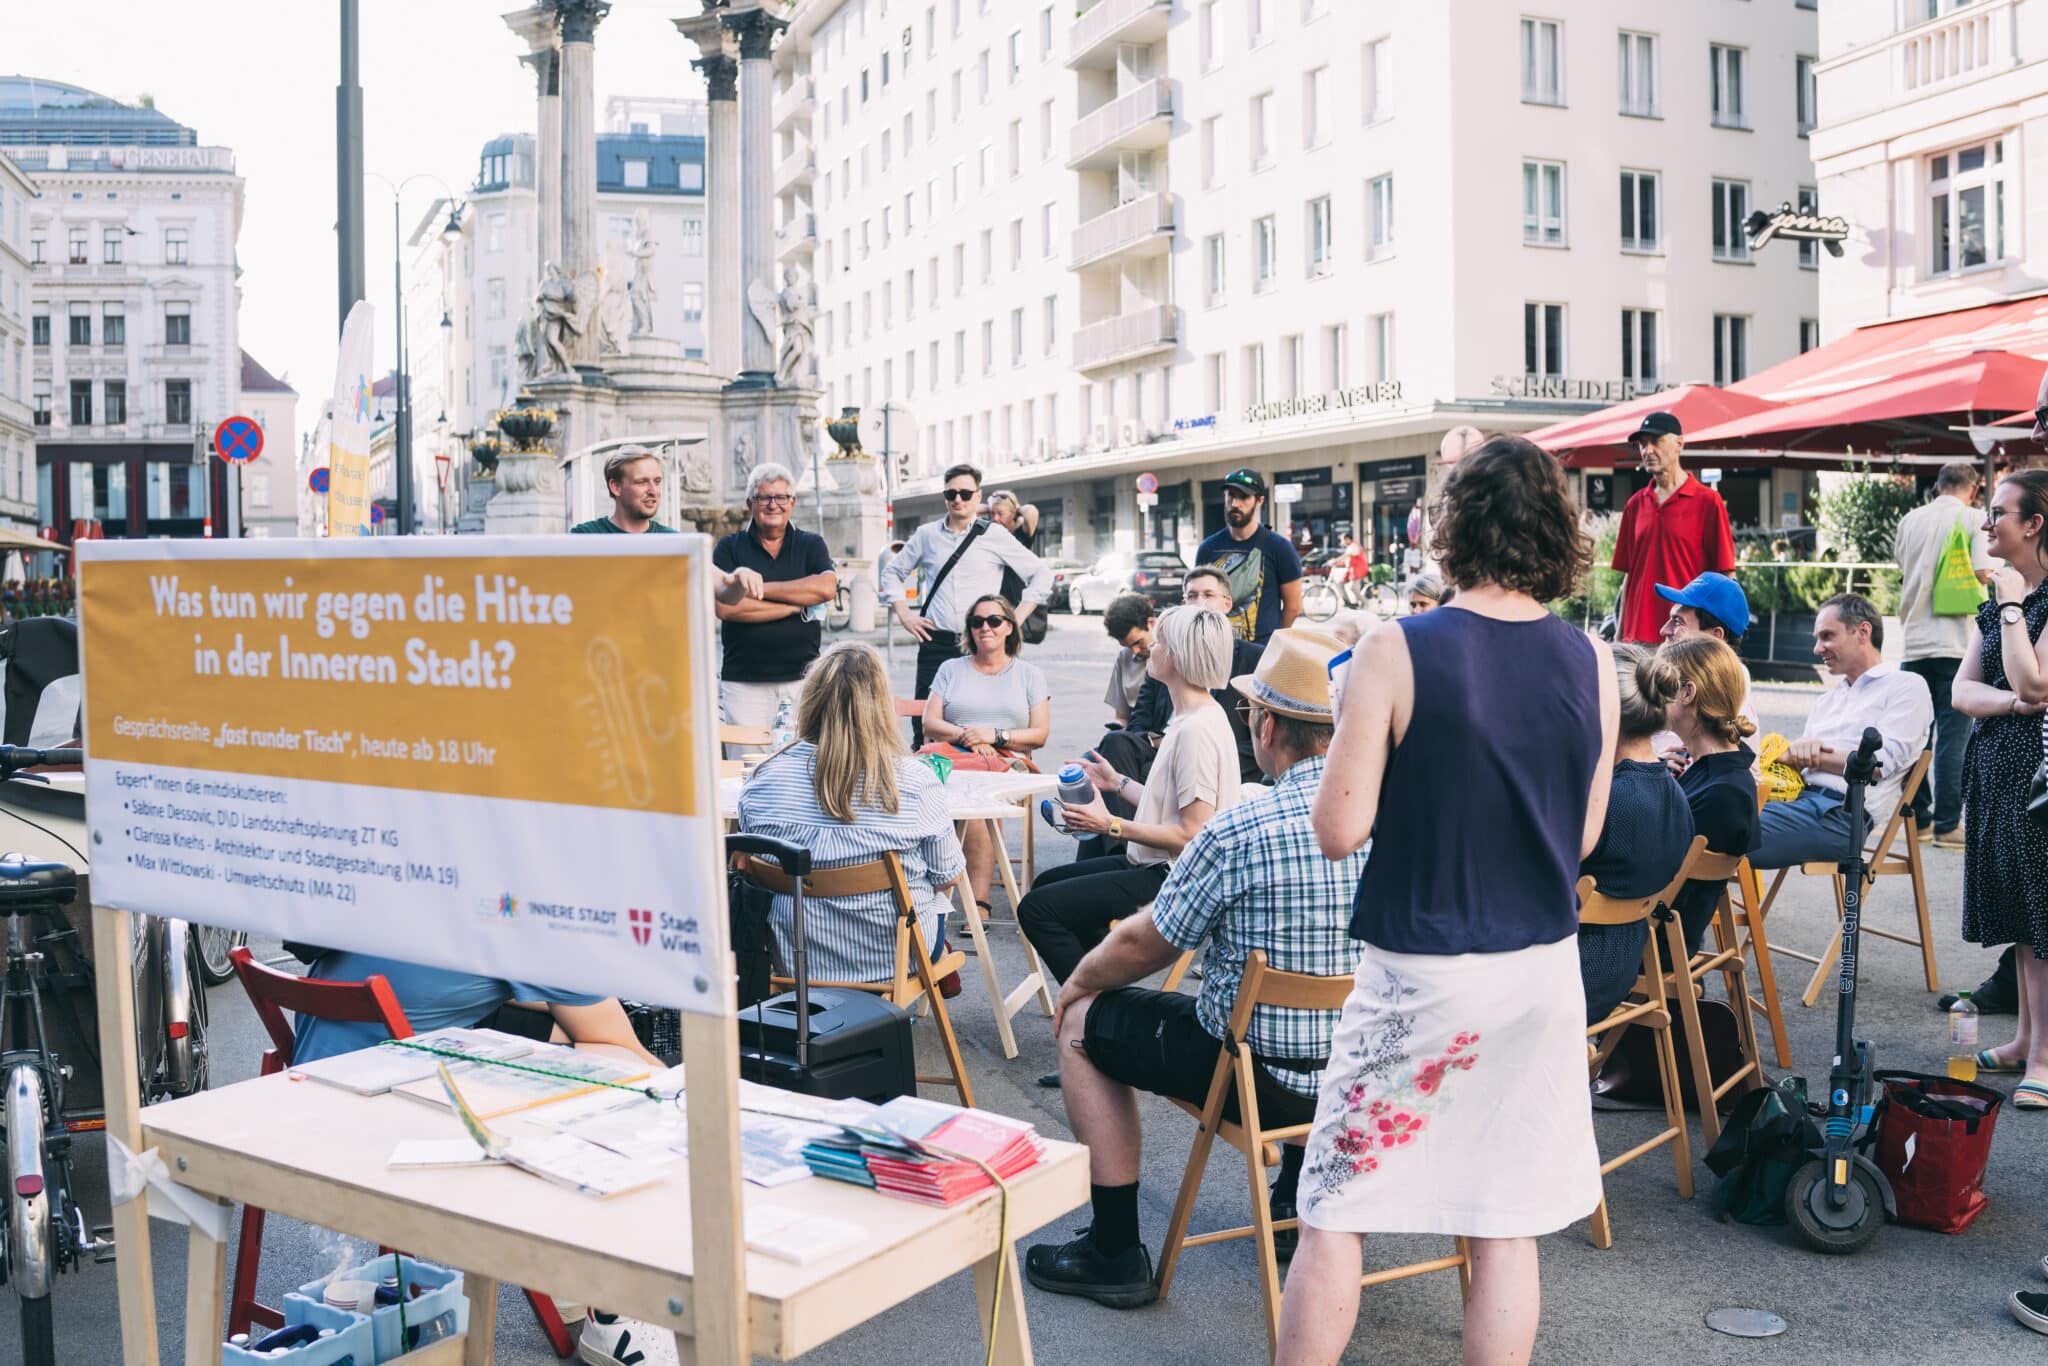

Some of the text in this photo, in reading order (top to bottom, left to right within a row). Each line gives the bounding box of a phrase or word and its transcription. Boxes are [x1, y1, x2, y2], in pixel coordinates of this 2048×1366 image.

[1246, 394, 1328, 424] SCHNEIDER
[1335, 381, 1402, 409] ATELIER
[1490, 375, 1636, 401] SCHNEIDER
[150, 574, 574, 640] Was tun wir gegen die Hitze
[194, 632, 516, 690] in der Inneren Stadt?
[113, 715, 211, 743] Gesprächsreihe
[251, 727, 302, 750] runder
[360, 732, 409, 760] heute
[411, 737, 434, 761] ab
[437, 739, 460, 764] 18
[463, 740, 497, 766] Uhr
[185, 779, 201, 795] die
[203, 782, 288, 804] mitdiskutieren:
[132, 800, 165, 819] Sabine
[242, 813, 358, 847] Landschaftsplanung
[361, 826, 376, 844] ZT
[380, 830, 399, 847] KG
[133, 826, 171, 847] Clarissa
[214, 837, 275, 861] Architektur
[278, 847, 302, 865] und
[305, 849, 402, 883] Stadtgestaltung
[405, 862, 434, 884] (MA
[437, 866, 460, 890] 19)
[135, 853, 156, 871] Max
[159, 857, 215, 881] Wittkowski
[224, 867, 306, 895] Umweltschutz
[308, 878, 333, 899] (MA
[337, 883, 357, 906] 22)
[578, 909, 617, 926] STADT
[659, 911, 699, 935] Stadt
[659, 933, 702, 956] Wien
